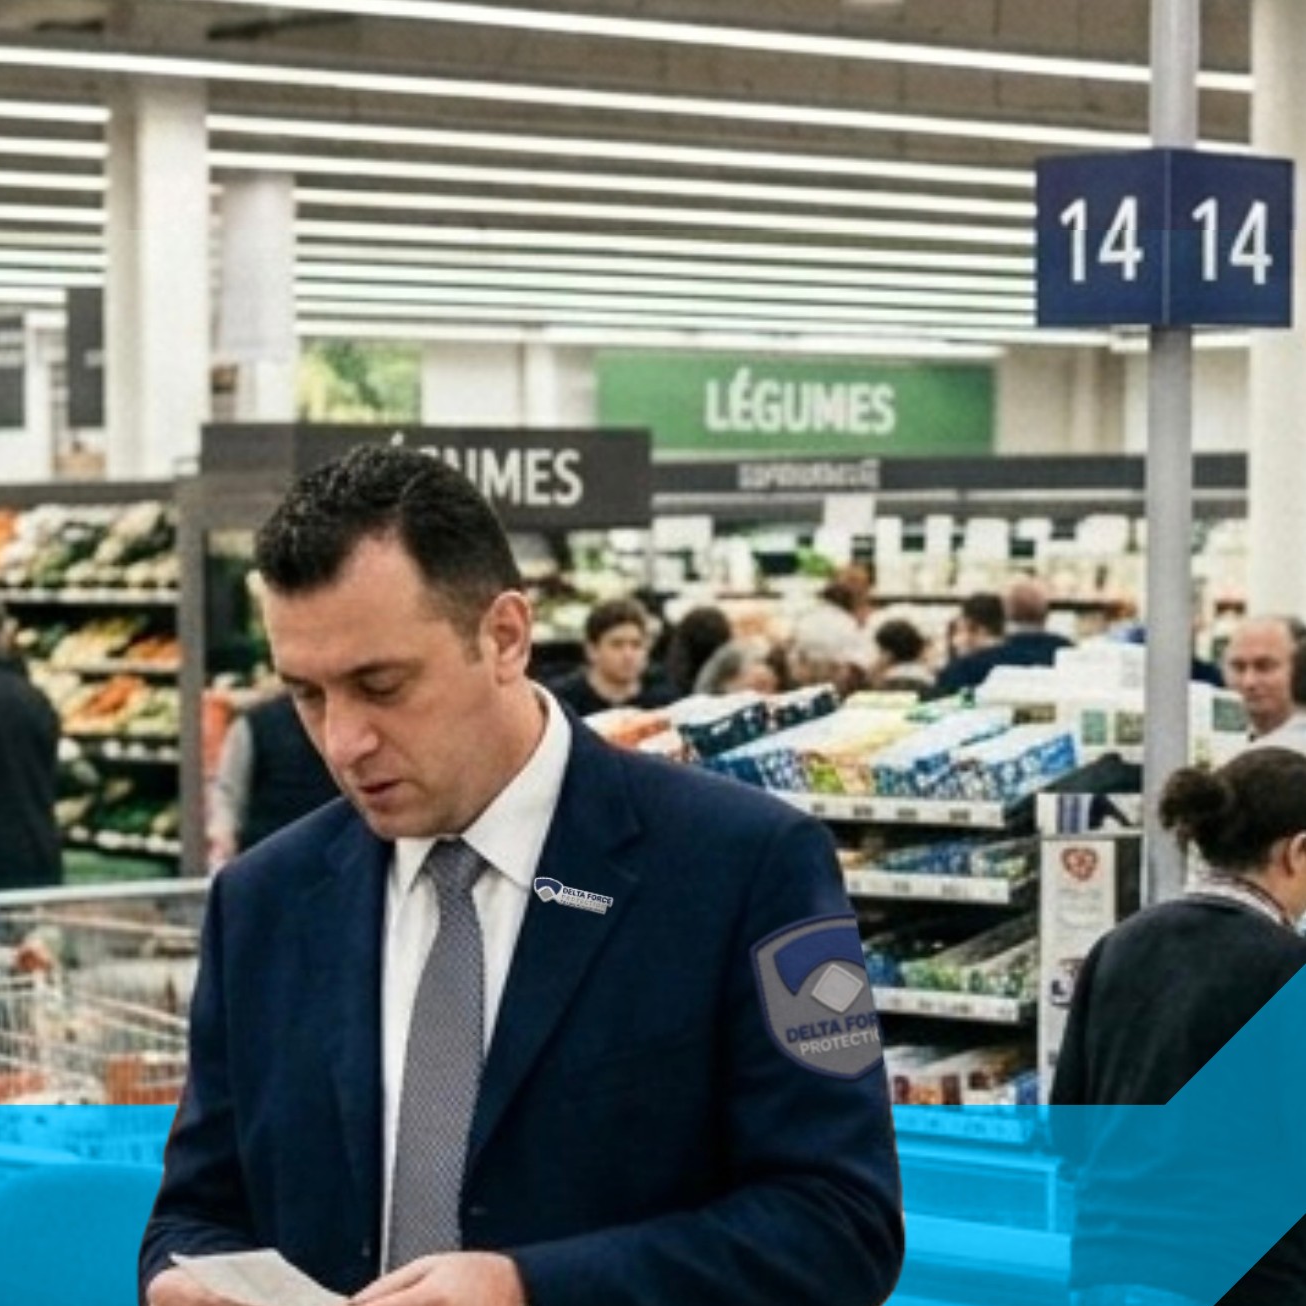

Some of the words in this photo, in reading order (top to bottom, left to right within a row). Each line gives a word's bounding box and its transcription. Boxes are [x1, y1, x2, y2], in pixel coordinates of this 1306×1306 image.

[1059, 195, 1144, 283] 14
[1191, 196, 1274, 286] 14
[705, 366, 898, 436] LÉGUMES
[562, 887, 586, 899] DELTA
[587, 893, 613, 905] FORCE
[786, 1019, 842, 1044] DELTA
